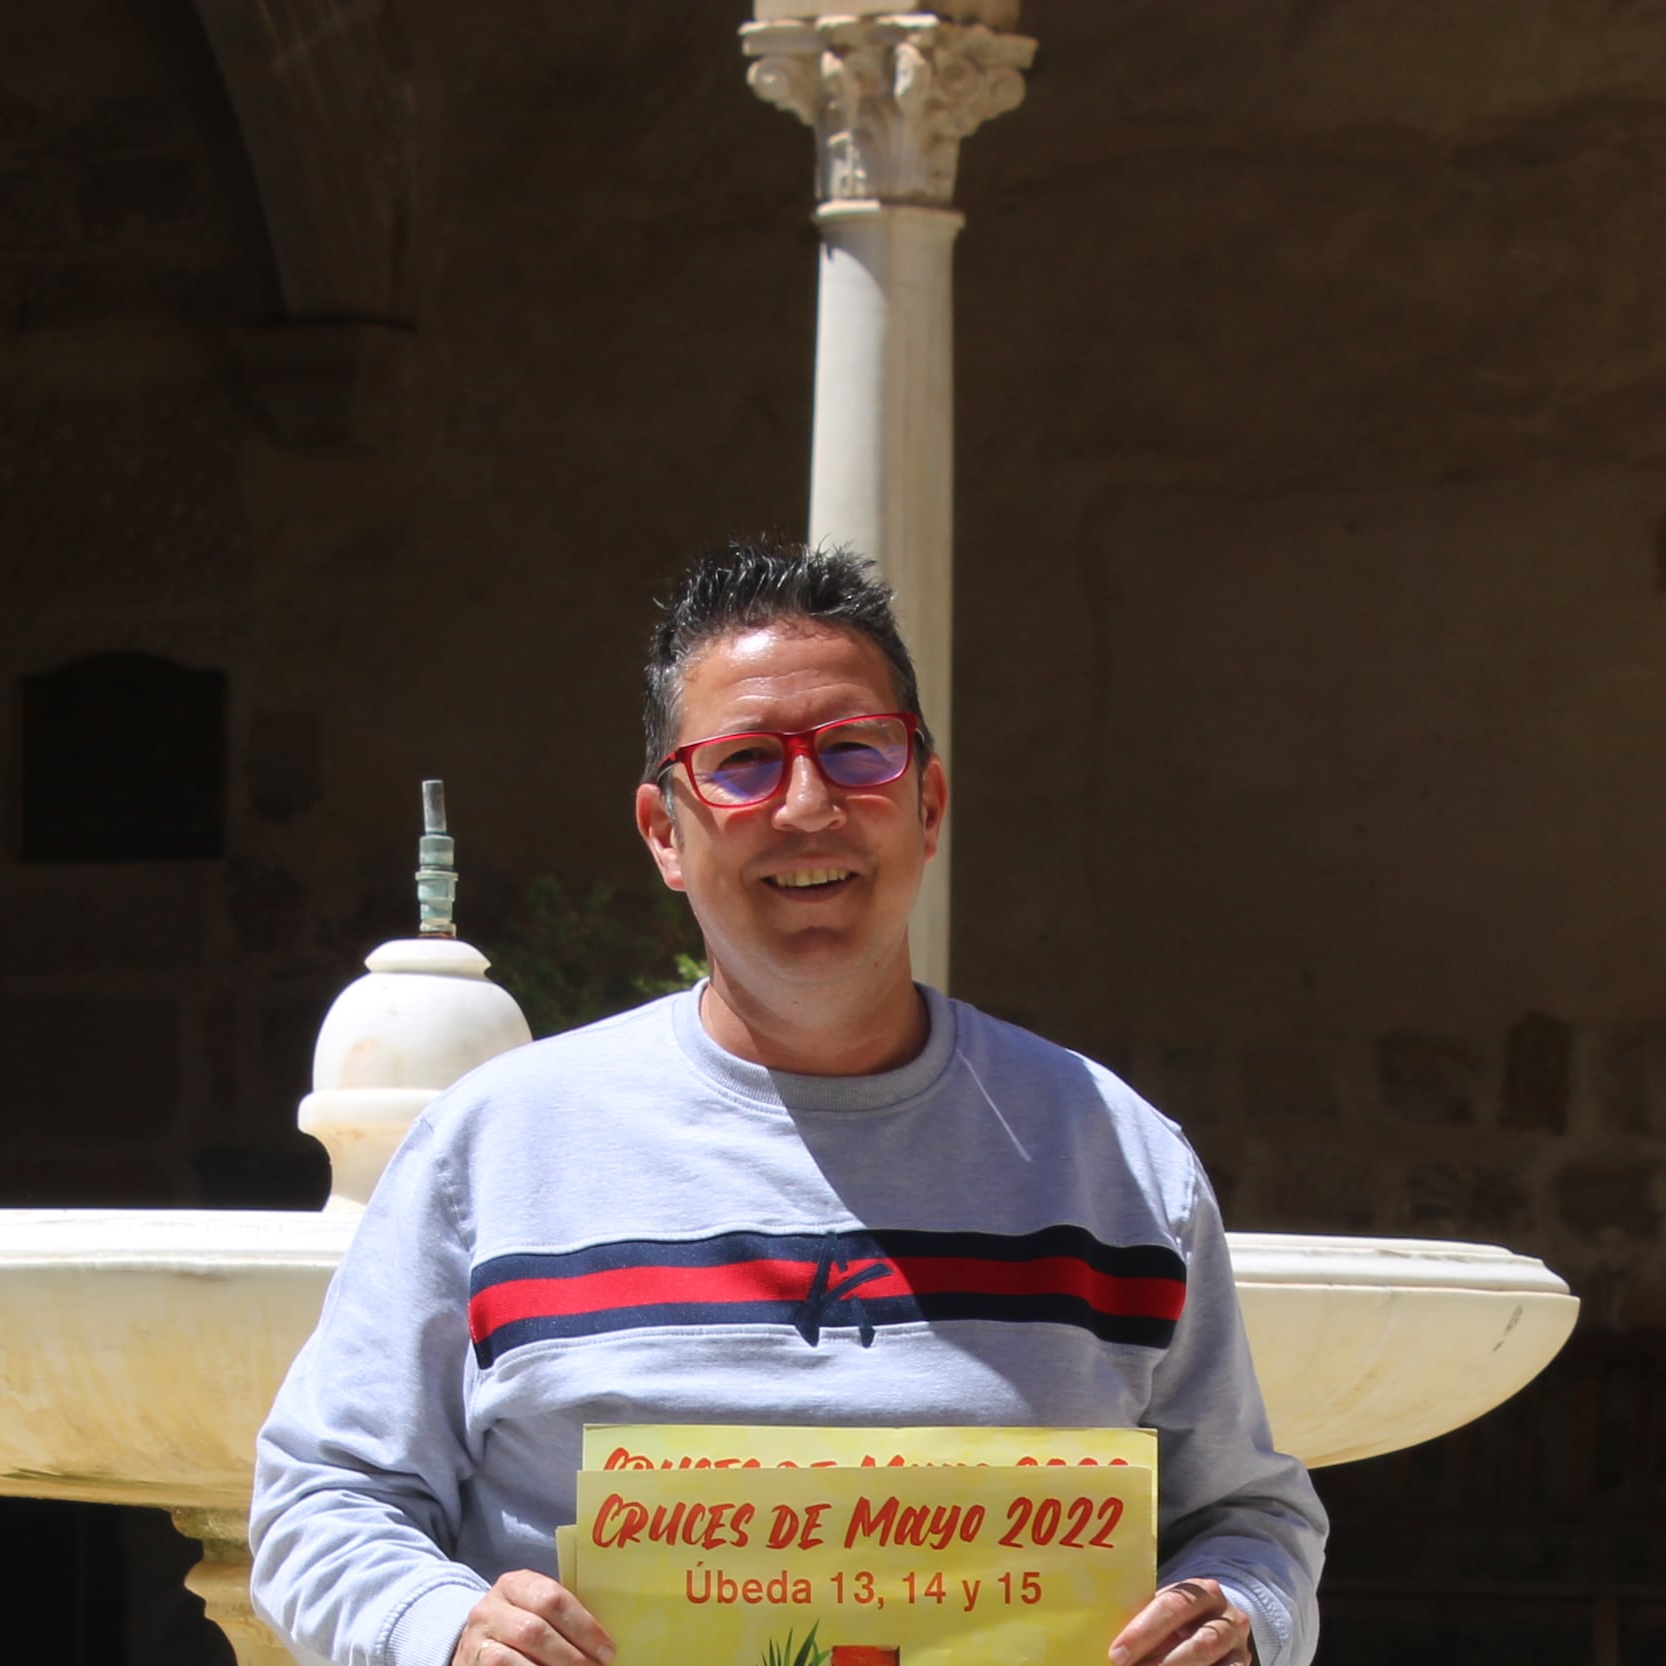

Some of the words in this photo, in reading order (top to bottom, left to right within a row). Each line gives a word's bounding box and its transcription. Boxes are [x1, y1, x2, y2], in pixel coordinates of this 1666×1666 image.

[765, 1503, 831, 1550] DE
[844, 1496, 986, 1550] Mayo
[997, 1496, 1124, 1549] 2022
[685, 1561, 813, 1604] Úbeda
[830, 1570, 884, 1609] 13,
[903, 1571, 946, 1604] 14
[962, 1578, 981, 1612] y
[998, 1571, 1043, 1604] 15
